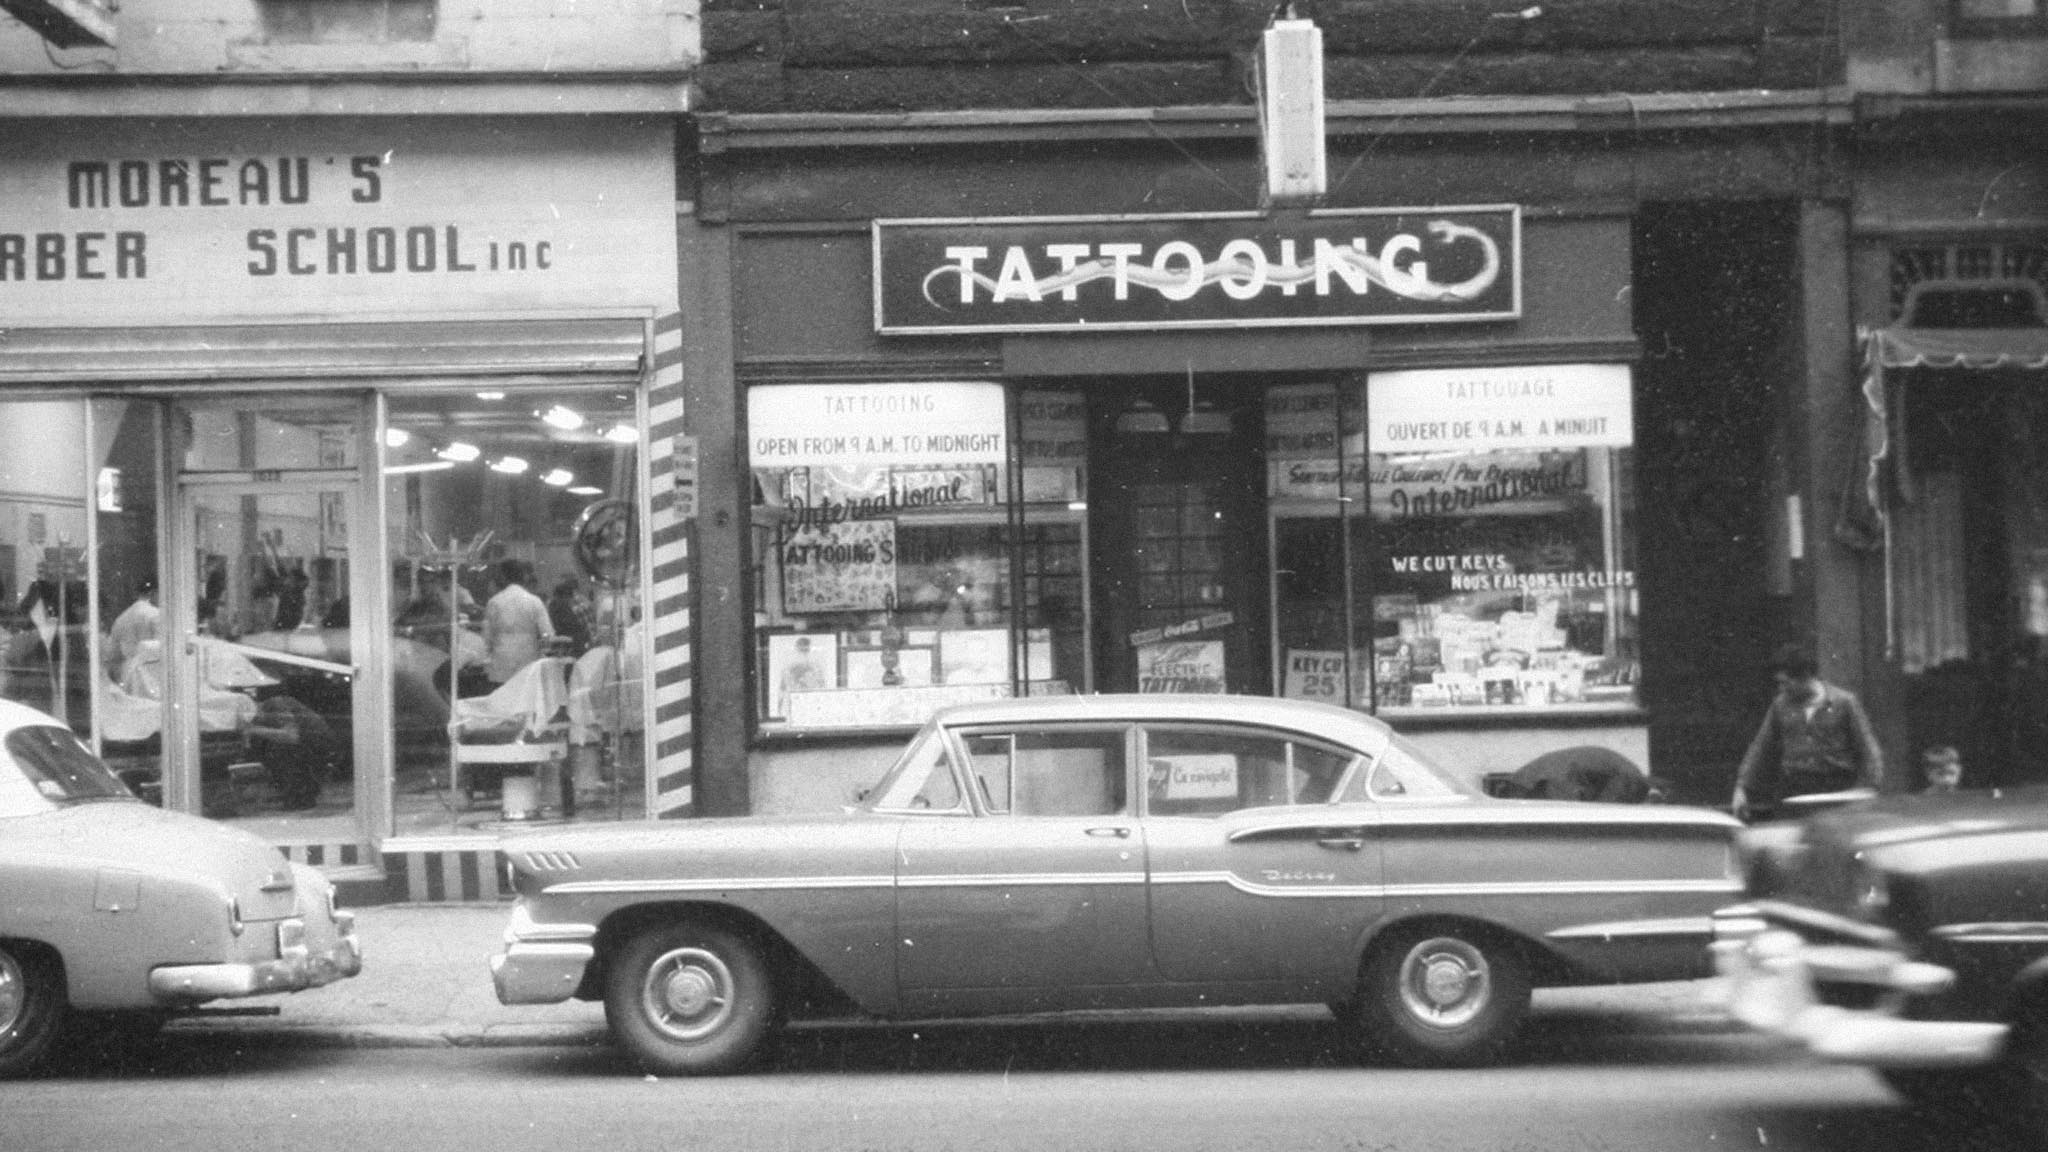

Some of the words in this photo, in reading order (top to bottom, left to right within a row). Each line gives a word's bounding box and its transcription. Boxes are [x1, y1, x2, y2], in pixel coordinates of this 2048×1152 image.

[67, 156, 382, 208] MOREAU'S
[247, 225, 476, 276] SCHOOL
[945, 234, 1428, 303] TATTOOING
[1446, 378, 1553, 399] TATTOUAGE
[824, 394, 935, 414] TATTOOING
[1386, 421, 1447, 441] OUVERT
[1452, 420, 1473, 440] DE
[1554, 416, 1608, 436] MINUIT
[756, 437, 798, 456] OPEN
[803, 436, 846, 455] FROM
[850, 435, 860, 453] 9
[865, 435, 898, 454] A.M.
[903, 434, 922, 453] TO
[927, 433, 1001, 453] MIDNIGHT
[1391, 555, 1419, 573] WE
[1422, 555, 1456, 573] CUT
[1461, 553, 1508, 571] KEYS
[1450, 574, 1491, 592] NOUS
[1493, 572, 1558, 592] FAISONS
[1559, 571, 1586, 589] LES
[1292, 656, 1321, 673] KEY
[1302, 674, 1336, 697] 25
